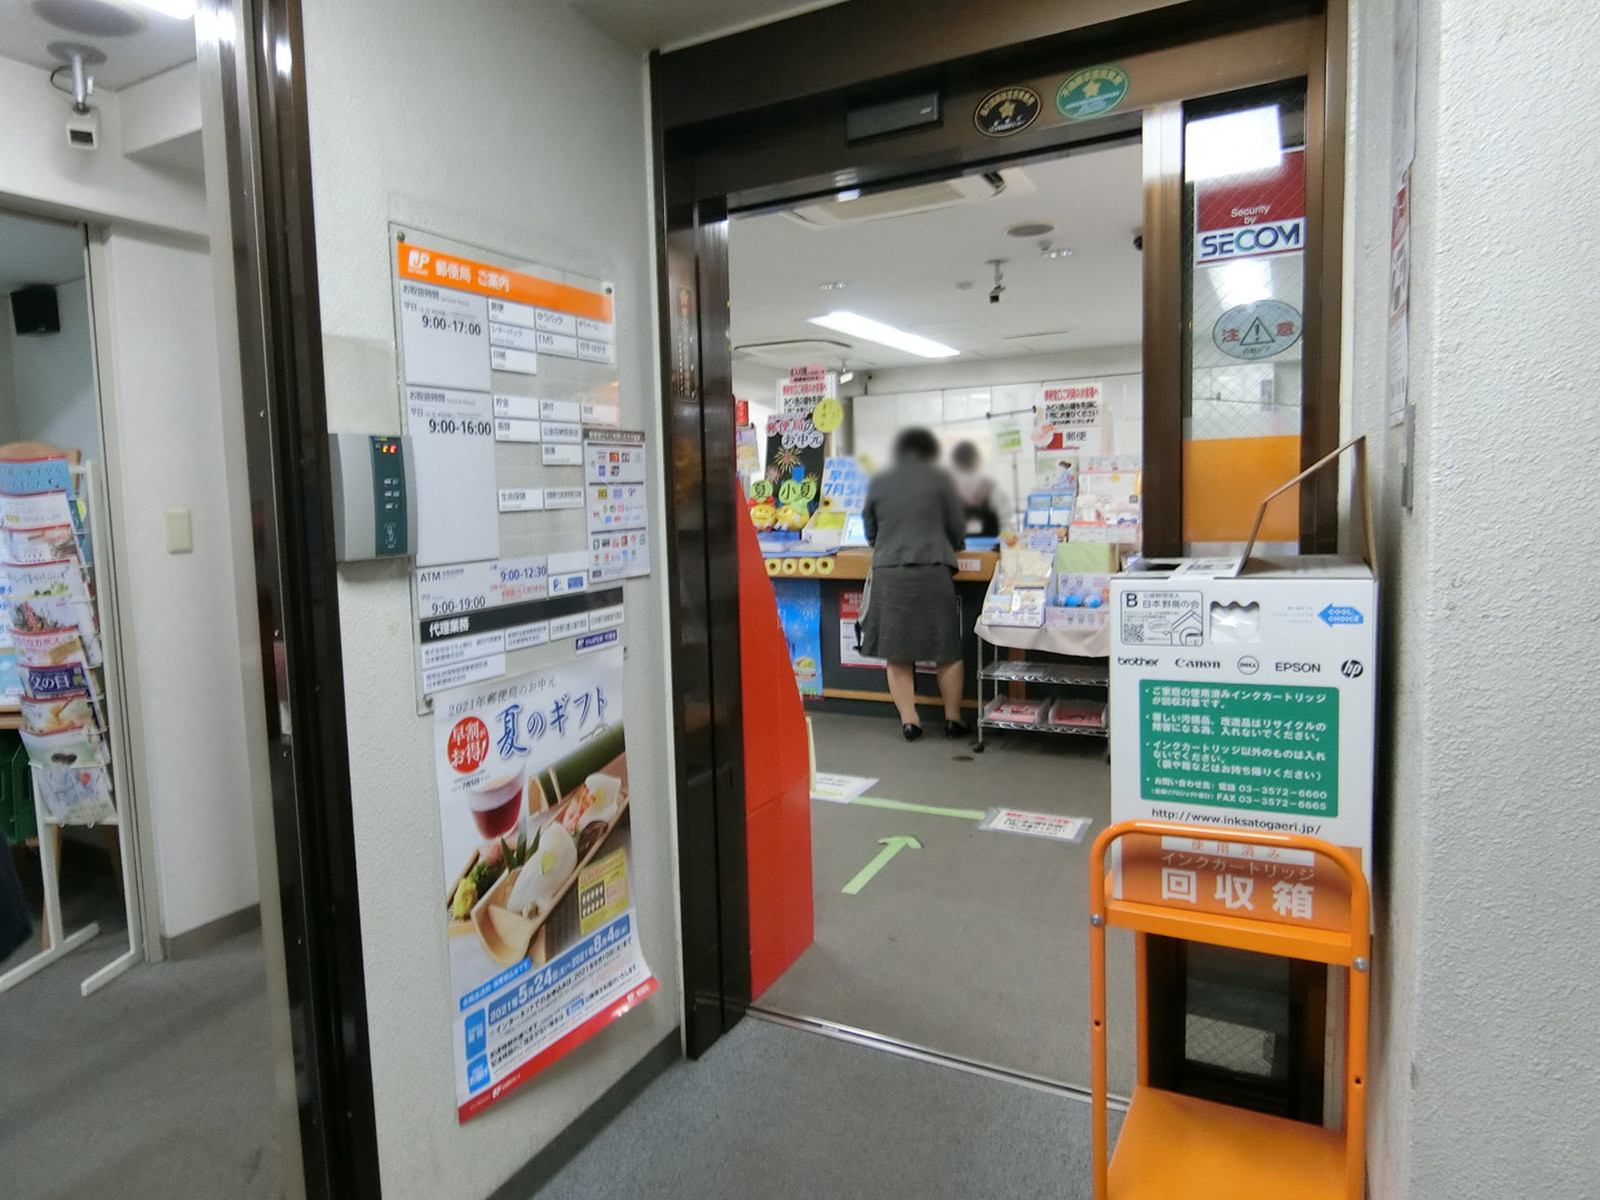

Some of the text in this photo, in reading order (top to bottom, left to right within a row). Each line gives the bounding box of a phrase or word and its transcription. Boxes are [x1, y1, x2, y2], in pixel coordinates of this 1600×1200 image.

[1231, 204, 1270, 218] Security
[1244, 217, 1256, 226] by
[1201, 224, 1300, 258] SECOM
[435, 258, 471, 283] 郵便局
[477, 270, 510, 293] ご案内
[421, 314, 481, 336] 9:00-17:00
[537, 333, 554, 346] EMS
[410, 407, 424, 418] 平日
[429, 418, 492, 437] 9:00-16:00
[1066, 431, 1086, 441] 郵便
[783, 433, 822, 446] お中元
[420, 572, 441, 584] ATM
[500, 566, 547, 582] 9:00-12:30
[431, 596, 486, 615] 9:00-19:00
[1126, 593, 1138, 608] B
[1143, 599, 1200, 610] 日本野鳥の会
[1328, 608, 1353, 616] COOL
[1328, 616, 1359, 624] CHOICE
[429, 616, 470, 637] 代理業務
[1118, 657, 1159, 668] brother
[1175, 658, 1221, 670] Canon
[1275, 662, 1321, 674] EPSON
[1342, 660, 1363, 679] hp
[448, 676, 556, 716] 2021年郵便局のお中元
[1152, 686, 1327, 704] ご家庭の使用済みインクカートリッジ
[1152, 696, 1225, 710] が回収対象です。
[495, 686, 608, 760] 夏のギフト
[1152, 741, 1327, 762] インクカートリッジ以外のものは入れ
[1153, 751, 1226, 764] ないでください。
[1216, 793, 1236, 804] FAX
[1151, 808, 1322, 836] http://www.inksatogaeri.jp/
[1191, 838, 1281, 860] 使用済み
[1162, 852, 1316, 882] インクカートリッジ
[1161, 867, 1316, 920] 回収箱
